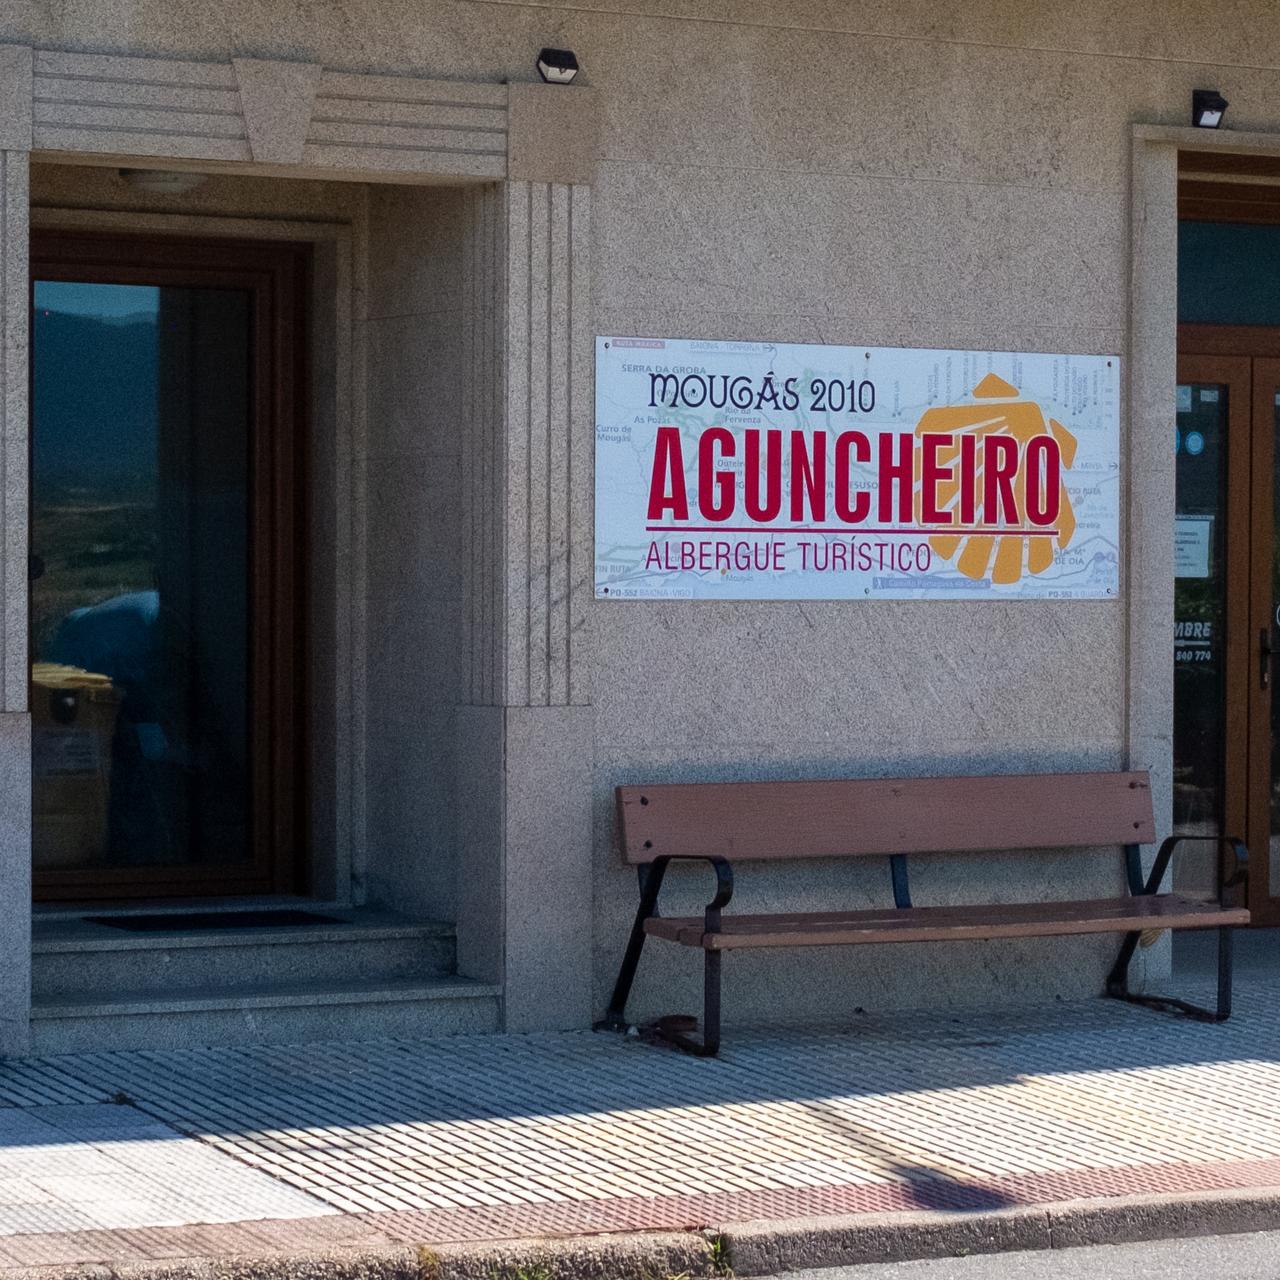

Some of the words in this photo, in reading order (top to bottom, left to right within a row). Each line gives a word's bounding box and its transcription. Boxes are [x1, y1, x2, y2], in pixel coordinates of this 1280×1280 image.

[621, 363, 652, 373] SERRA
[655, 365, 670, 374] DA
[671, 365, 707, 374] GROBA
[648, 371, 800, 411] MOUGÁS
[810, 379, 875, 413] 2010
[647, 426, 1060, 527] AGUNCHEIRO
[646, 540, 786, 571] ALBERGUE
[797, 535, 932, 572] TURÍSTICO
